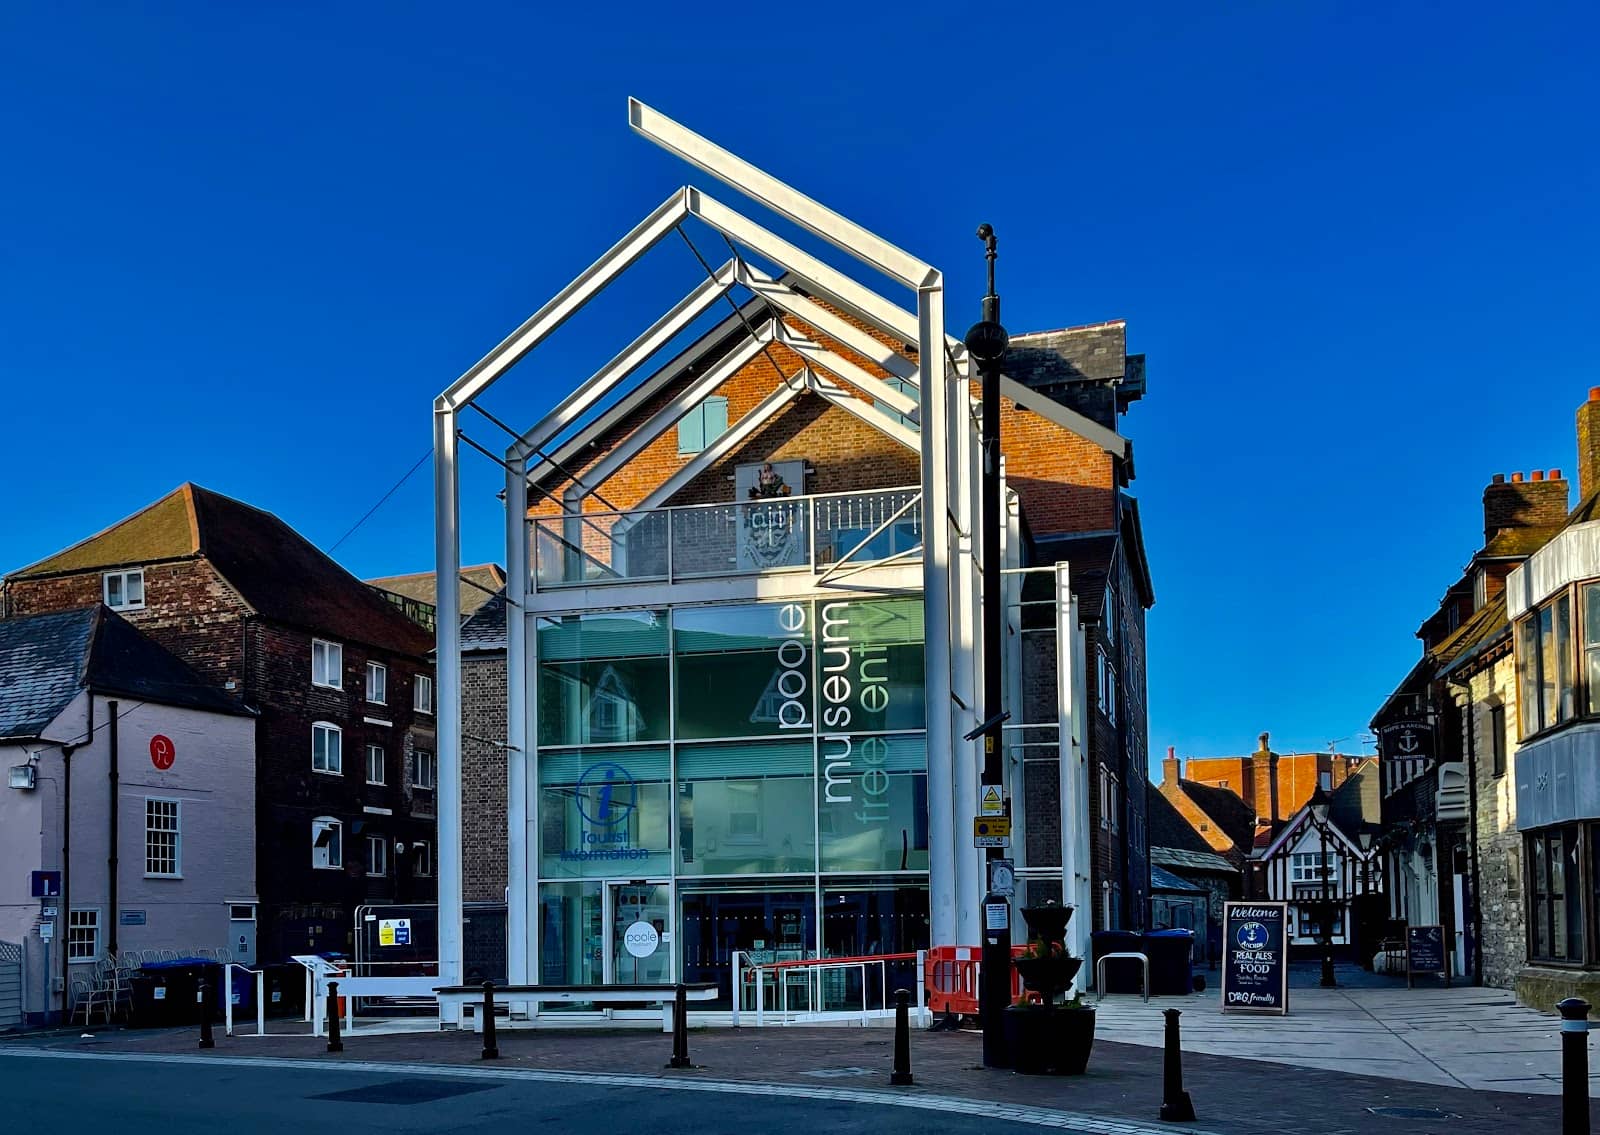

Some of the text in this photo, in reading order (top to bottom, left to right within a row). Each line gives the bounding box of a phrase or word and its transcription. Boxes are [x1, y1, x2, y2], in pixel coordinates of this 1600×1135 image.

[769, 604, 812, 729] poole
[822, 602, 852, 802] museum
[852, 603, 896, 824] free entry
[583, 829, 627, 844] Tourist
[1231, 906, 1280, 918] Welcome
[626, 930, 657, 946] poole
[1236, 952, 1273, 960] REAL ALES
[1240, 964, 1270, 974] FOOD
